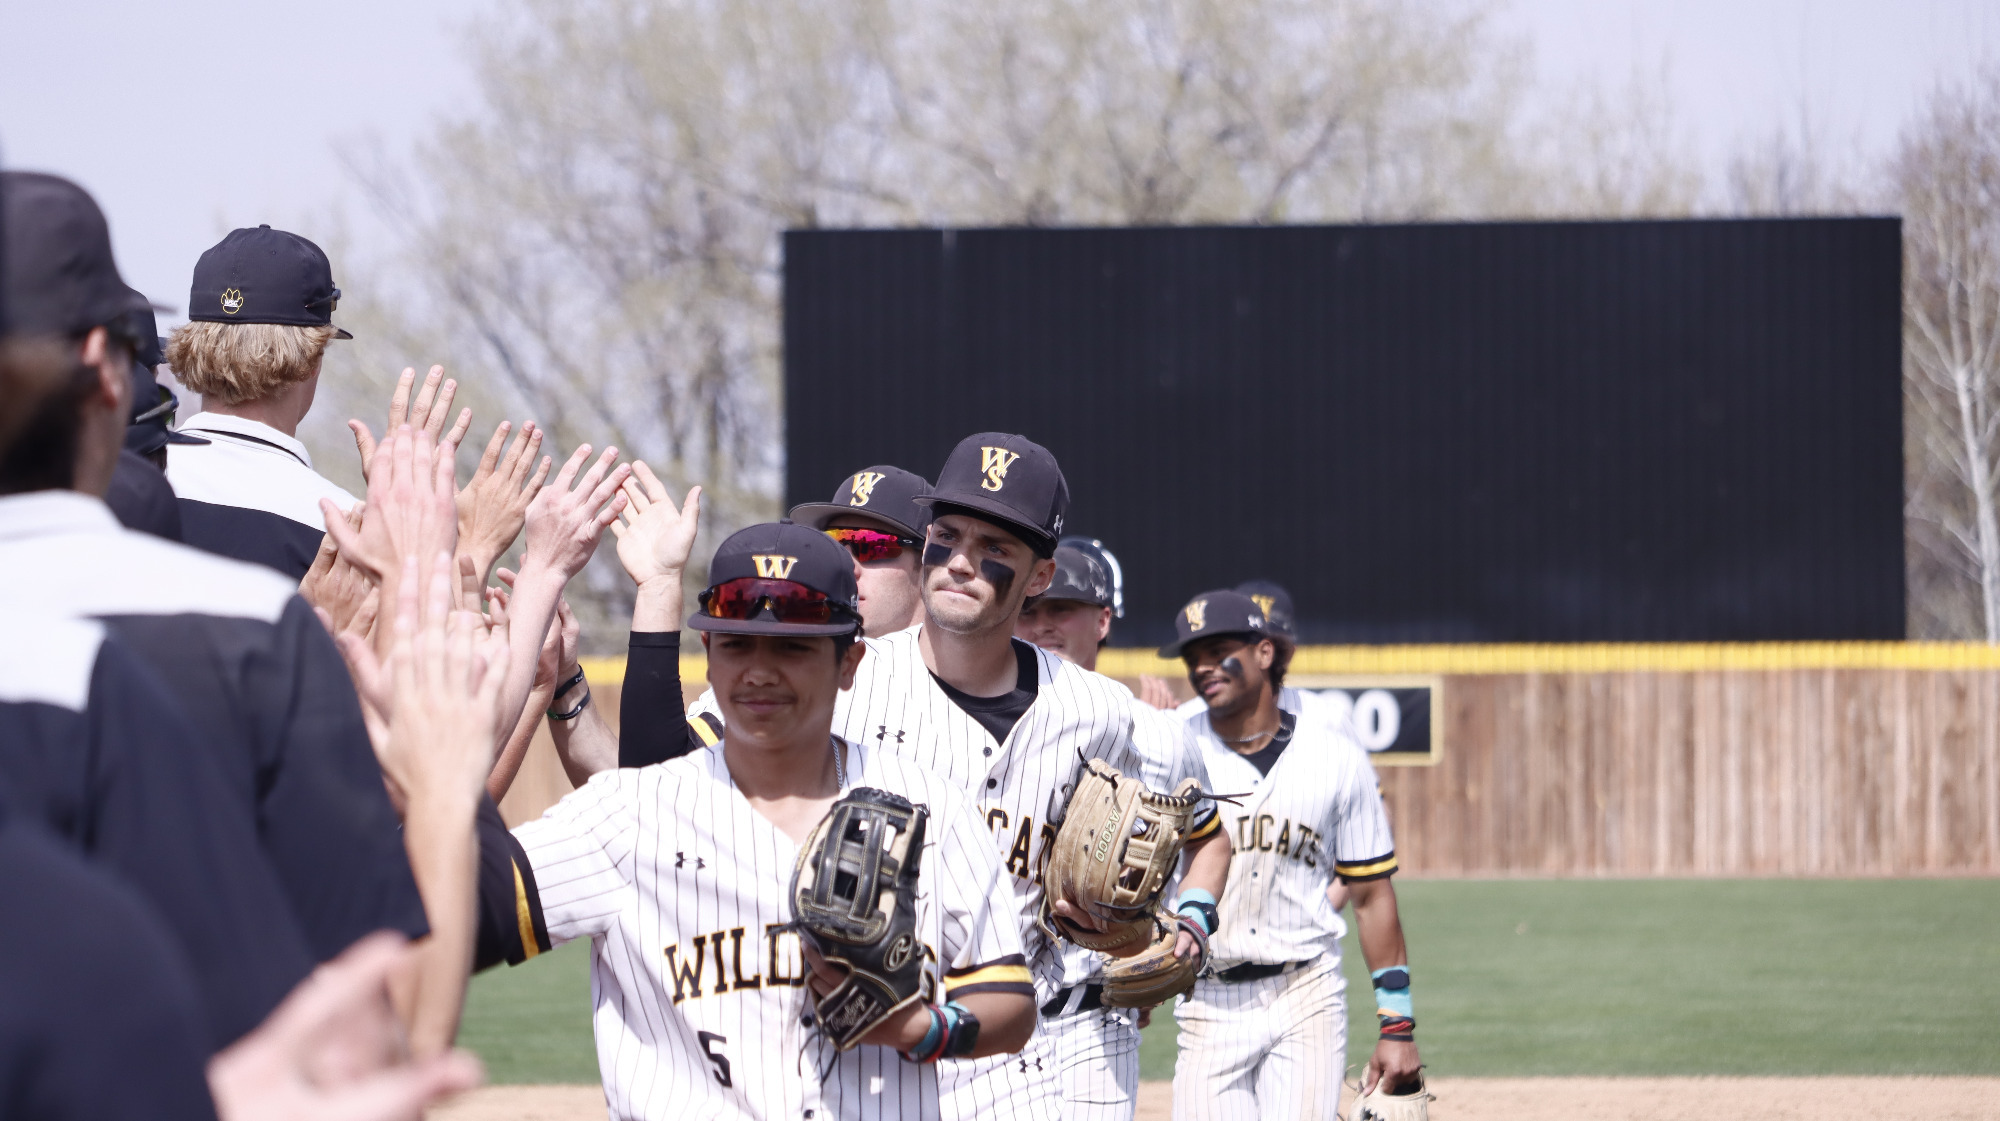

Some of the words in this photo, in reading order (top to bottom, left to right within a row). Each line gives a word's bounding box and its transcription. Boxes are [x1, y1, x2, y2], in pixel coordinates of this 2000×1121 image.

[751, 554, 799, 580] W
[1095, 808, 1121, 864] A2000
[664, 924, 807, 1006] WILD
[697, 1030, 733, 1088] 5
